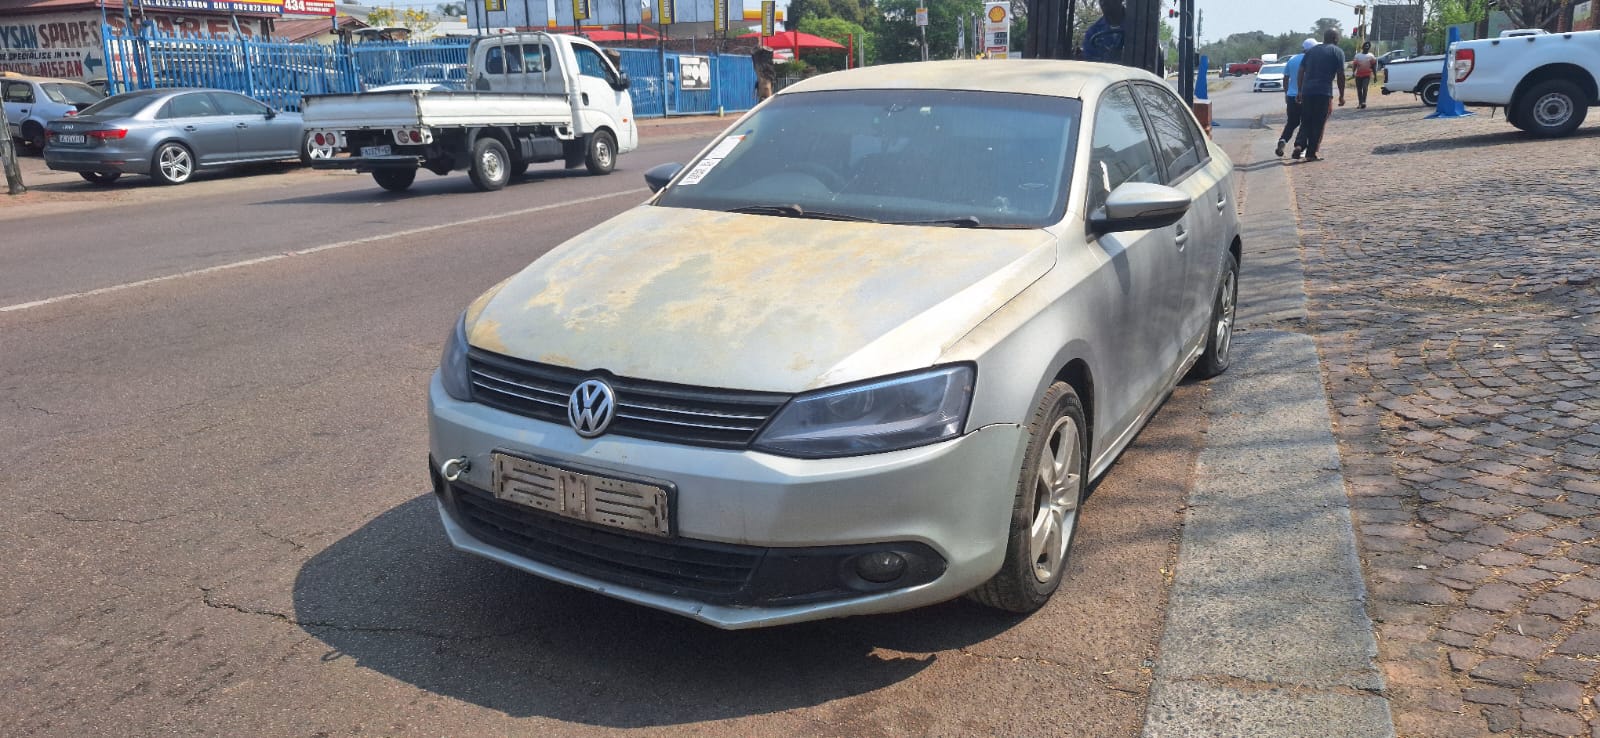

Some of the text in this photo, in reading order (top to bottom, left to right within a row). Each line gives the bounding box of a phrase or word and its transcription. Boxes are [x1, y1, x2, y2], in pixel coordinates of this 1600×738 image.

[284, 0, 305, 12] 434
[39, 20, 102, 49] SPARES
[9, 51, 52, 60] SPECIALISE
[54, 51, 62, 59] IN
[40, 59, 84, 78] NISSAN
